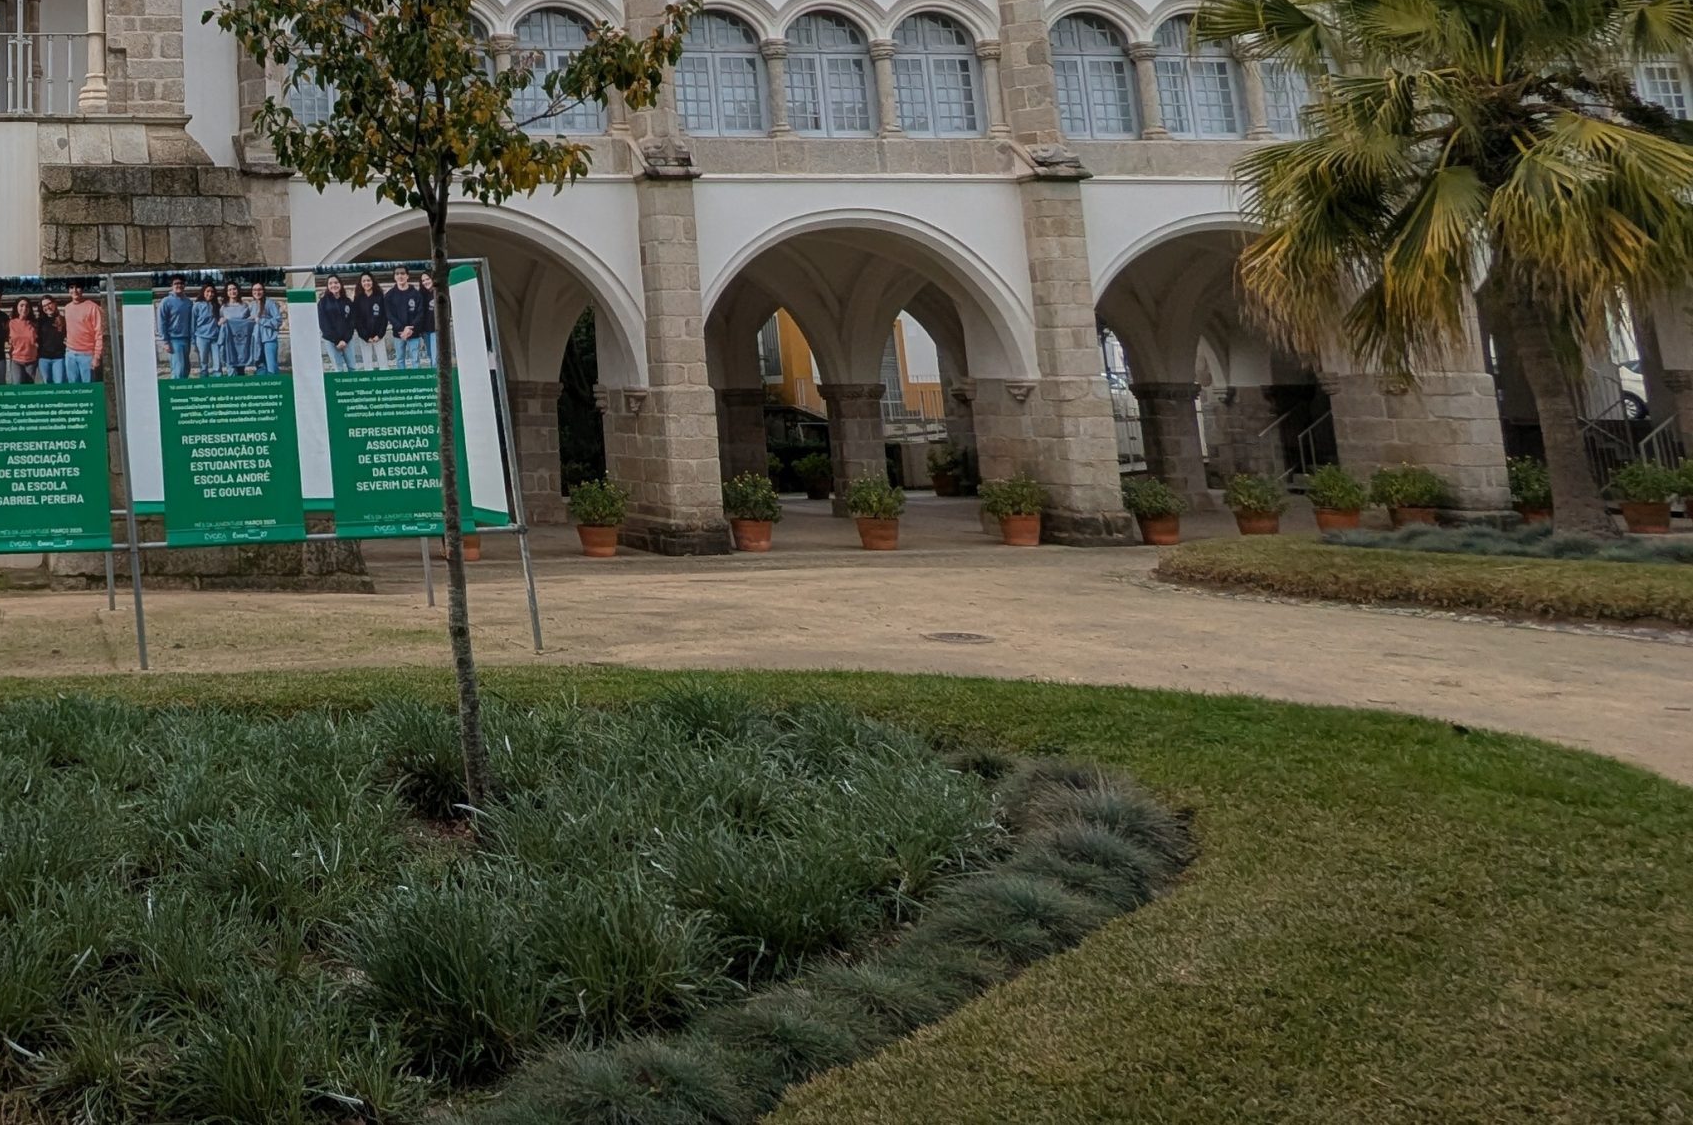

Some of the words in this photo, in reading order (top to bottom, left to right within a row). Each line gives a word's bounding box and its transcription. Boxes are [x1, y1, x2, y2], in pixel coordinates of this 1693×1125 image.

[349, 425, 434, 438] REPRESENTAMOS
[79, 440, 86, 449] A
[182, 432, 268, 445] REPRESENTAMOS
[270, 432, 277, 441] A
[366, 437, 429, 452] ASSOCIAÇÃO
[191, 446, 254, 459] ASSOCIAÇÃO
[256, 447, 269, 455] DE
[358, 454, 372, 464] DE
[374, 452, 439, 464] ESTUDANTES
[7, 453, 70, 467] ASSOCIAÇÃO
[191, 460, 256, 472] ESTUDANTES
[258, 459, 272, 469] DA
[14, 467, 80, 478] ESTUDANTES
[372, 467, 386, 477] DA
[388, 465, 428, 477] ESCOLA
[194, 475, 234, 485] ESCOLA
[236, 471, 270, 483] ANDRÉ
[12, 482, 25, 492] DA
[27, 481, 68, 491] ESCOLA
[356, 481, 400, 491] SEVERIM
[402, 480, 415, 490] DE
[204, 488, 217, 498] DE
[219, 486, 262, 498] GOUVEIA
[41, 494, 84, 505] PEREIRA
